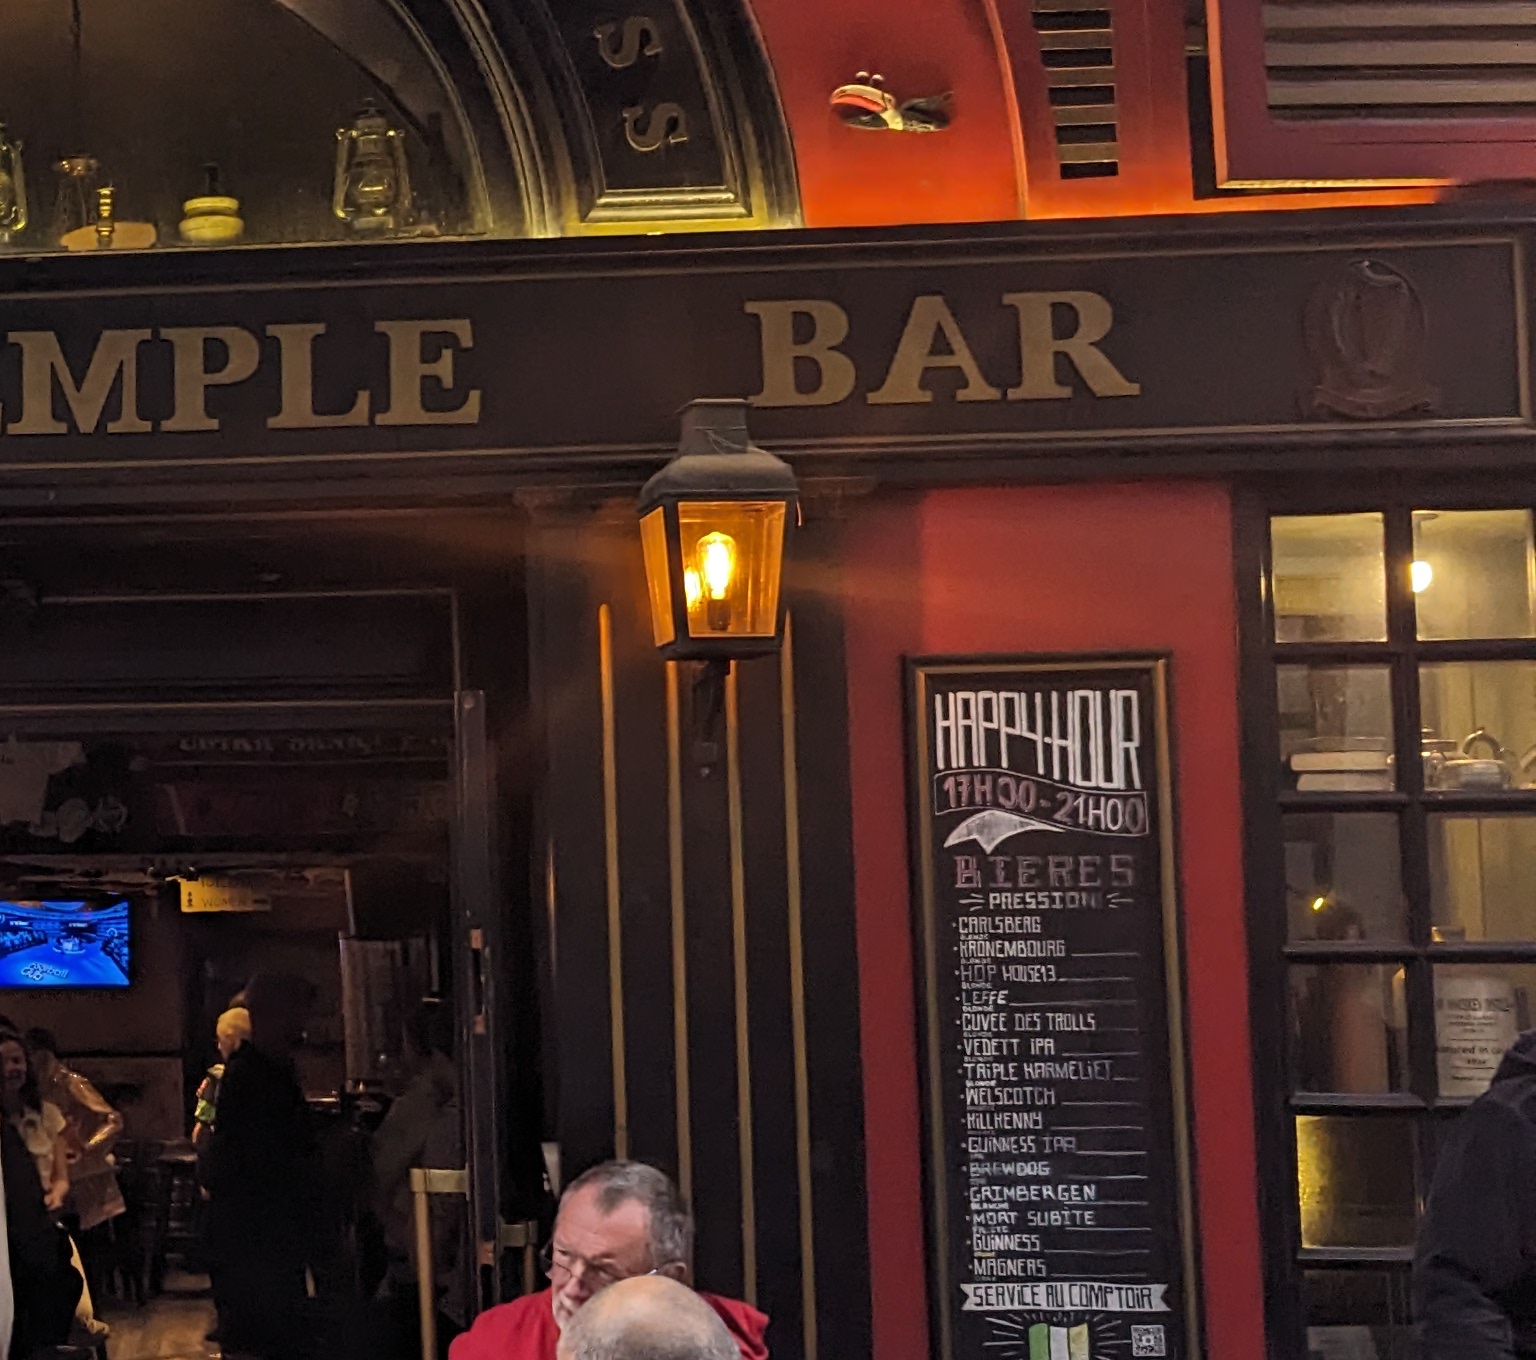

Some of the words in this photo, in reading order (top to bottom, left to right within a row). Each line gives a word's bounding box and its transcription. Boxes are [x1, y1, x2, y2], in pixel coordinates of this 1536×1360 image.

[744, 290, 1141, 407] BAR
[954, 854, 1135, 888] BIERES
[989, 891, 1103, 910] PRESSION
[959, 916, 1041, 933] CARLSBERG
[959, 940, 1066, 958] KRONEMBOURG
[961, 964, 997, 982] HOP
[962, 990, 1009, 1006] LEFFE
[963, 1013, 1007, 1031] CUVEE
[1015, 1013, 1040, 1031] DES
[1046, 1012, 1096, 1031] TROLLS
[964, 1038, 1019, 1056] VEDETT
[965, 1087, 1056, 1106] WELSCOTCH
[969, 1162, 1051, 1178] BREWDOG
[969, 1183, 1097, 1203] GRIMBERGEN
[972, 1210, 1018, 1226] MORT
[974, 1258, 1047, 1277] MAGNERS
[1046, 1283, 1064, 1308] AU
